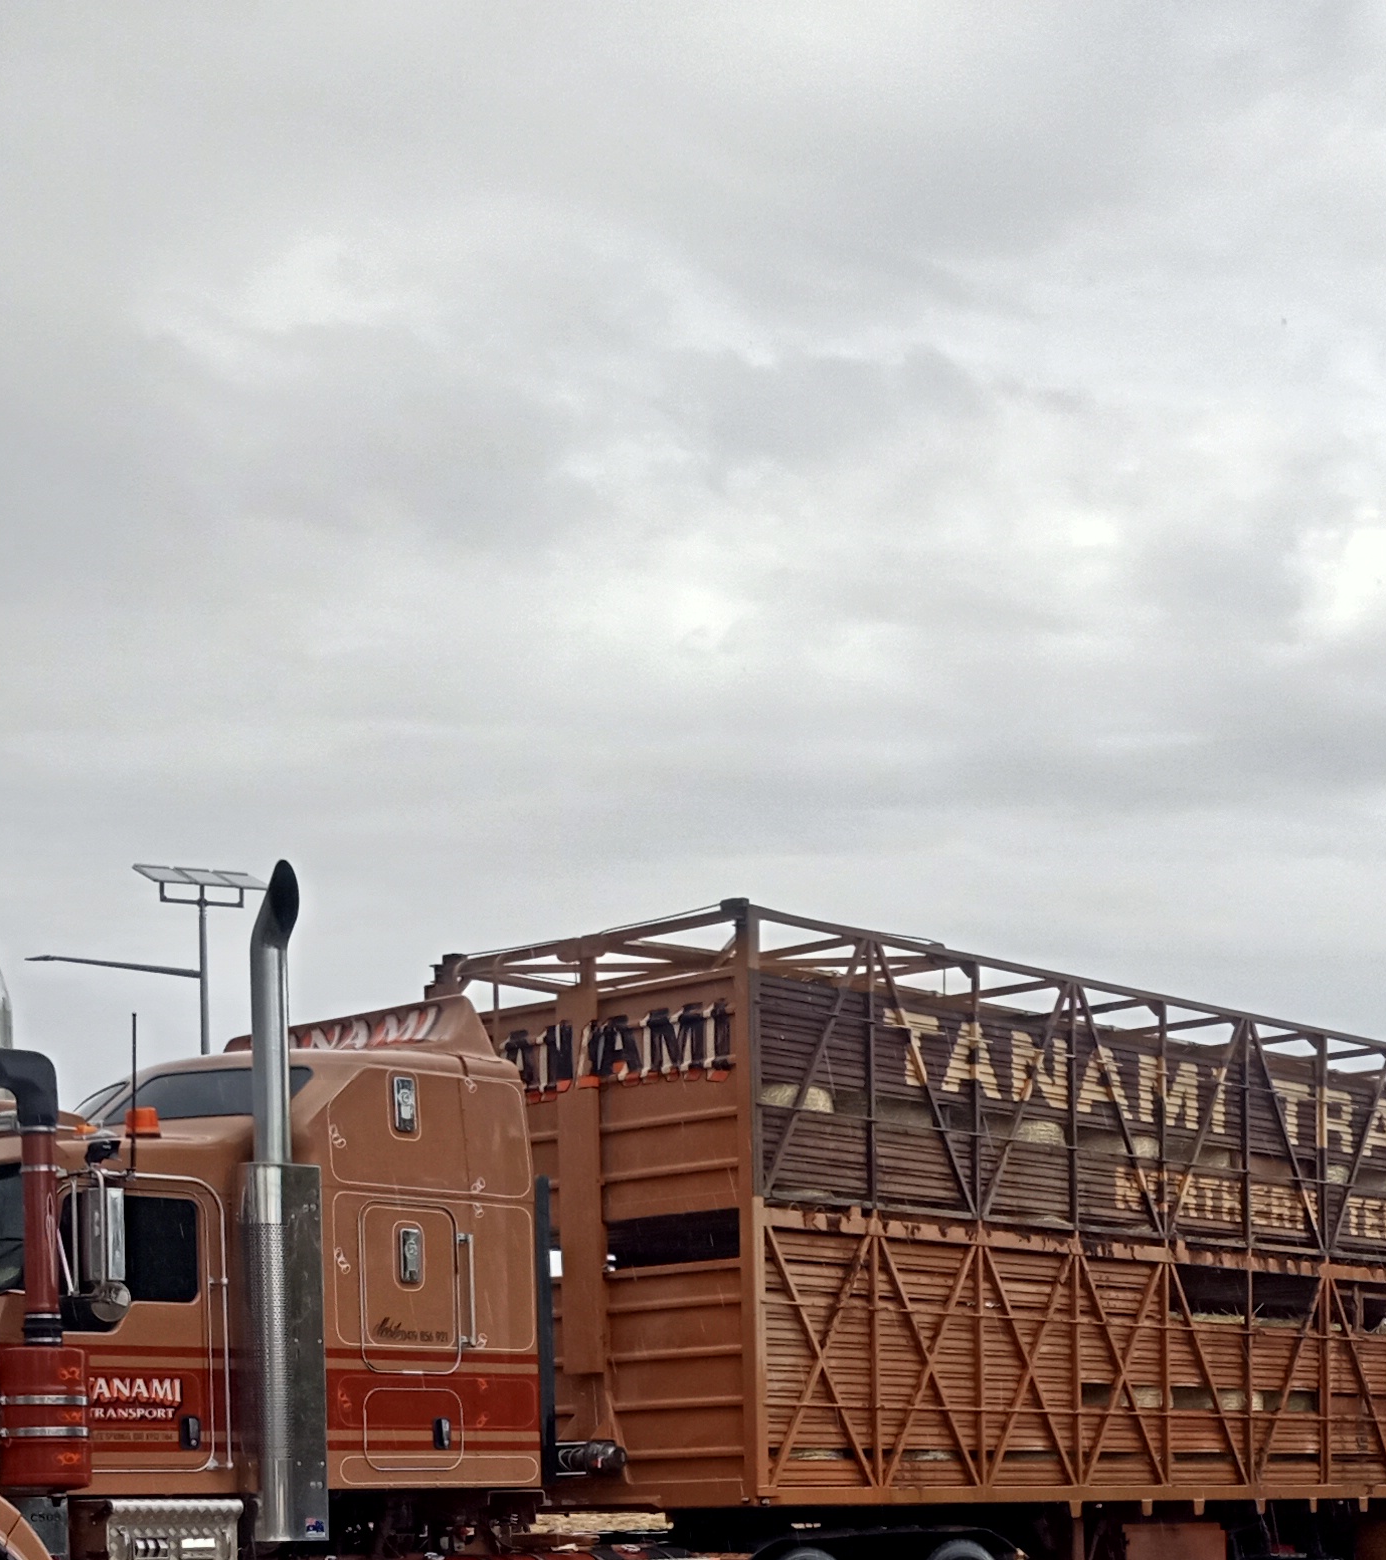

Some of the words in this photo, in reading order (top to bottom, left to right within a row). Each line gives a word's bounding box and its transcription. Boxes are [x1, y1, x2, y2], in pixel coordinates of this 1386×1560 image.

[289, 1004, 440, 1050] NAMI
[501, 998, 736, 1105] ANAMI
[883, 1007, 1227, 1134] TANAMI
